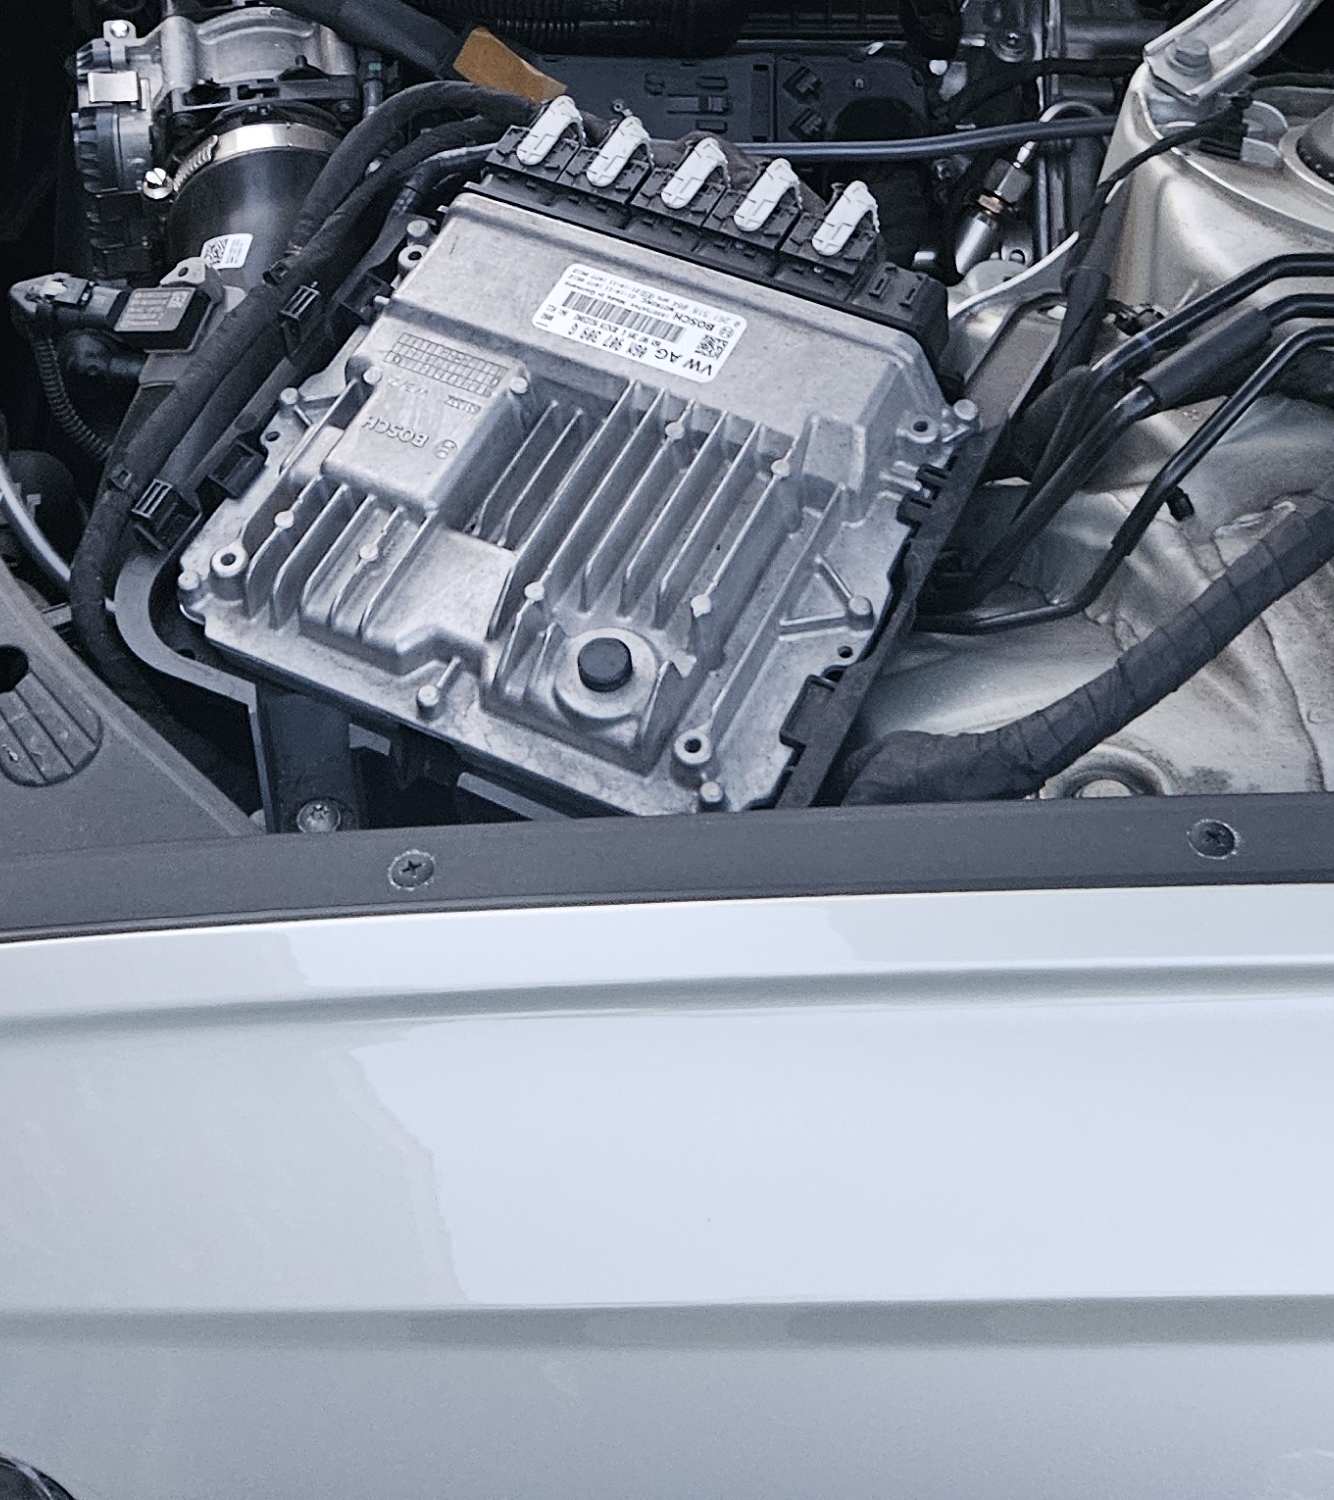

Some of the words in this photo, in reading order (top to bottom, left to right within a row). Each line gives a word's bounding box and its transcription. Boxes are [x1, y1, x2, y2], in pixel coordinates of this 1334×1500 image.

[674, 312, 715, 331] BOSCH
[652, 346, 683, 365] AG
[681, 356, 715, 376] VW
[361, 415, 430, 448] BOSCH
